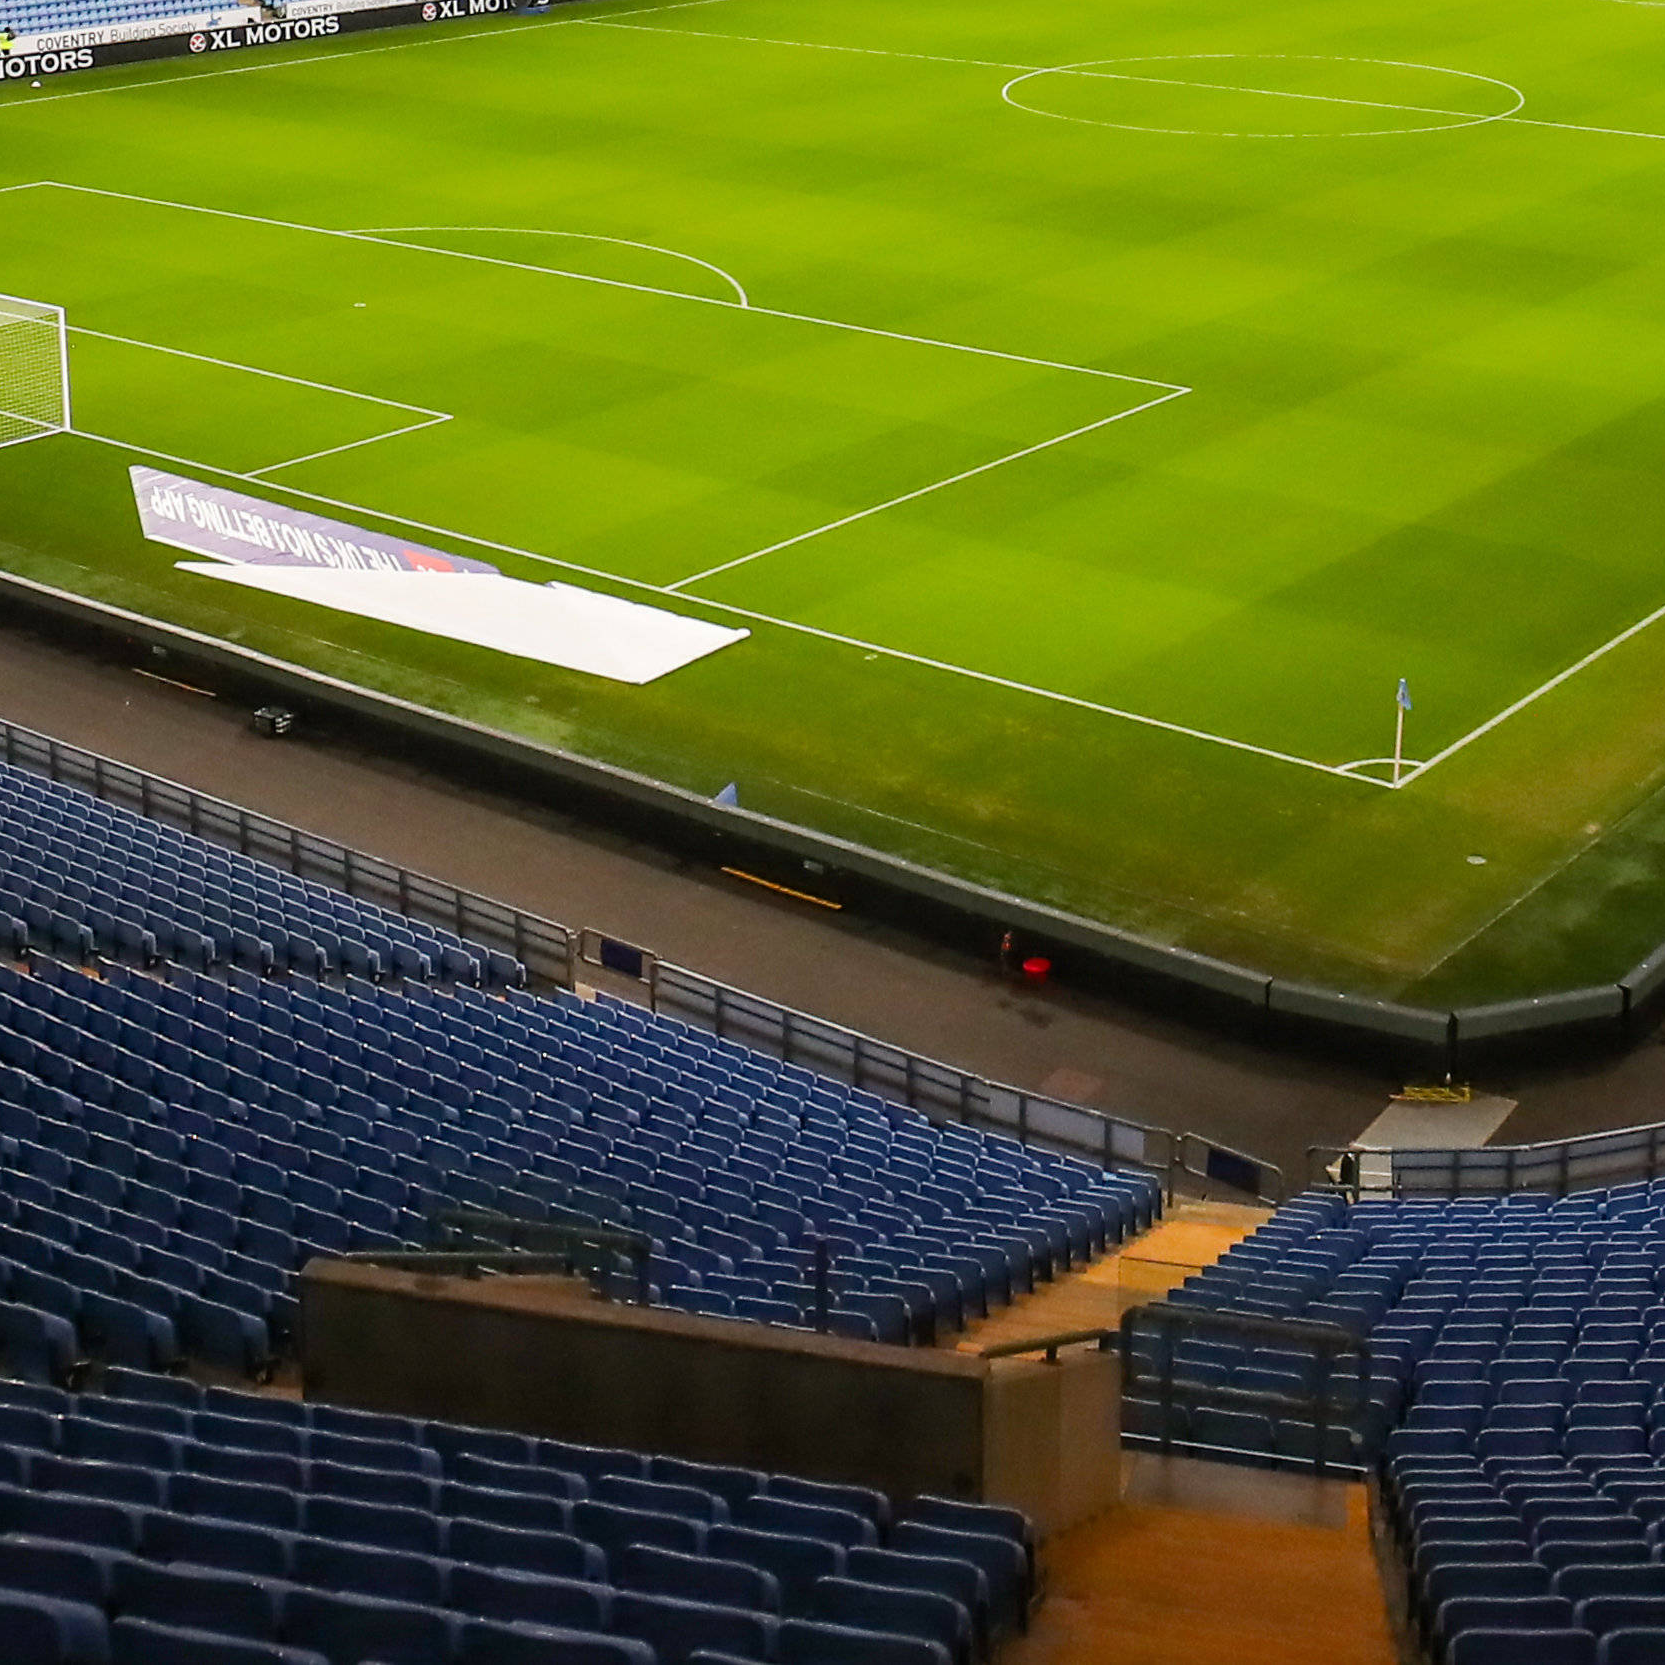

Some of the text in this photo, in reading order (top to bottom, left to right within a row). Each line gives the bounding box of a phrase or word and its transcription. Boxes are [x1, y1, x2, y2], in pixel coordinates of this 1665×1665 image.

[291, 4, 333, 17] COVENTRY
[36, 32, 104, 52] COVENTRY
[210, 15, 339, 51] XL MOTORS
[150, 484, 186, 522] APP
[190, 493, 269, 548] BETTING
